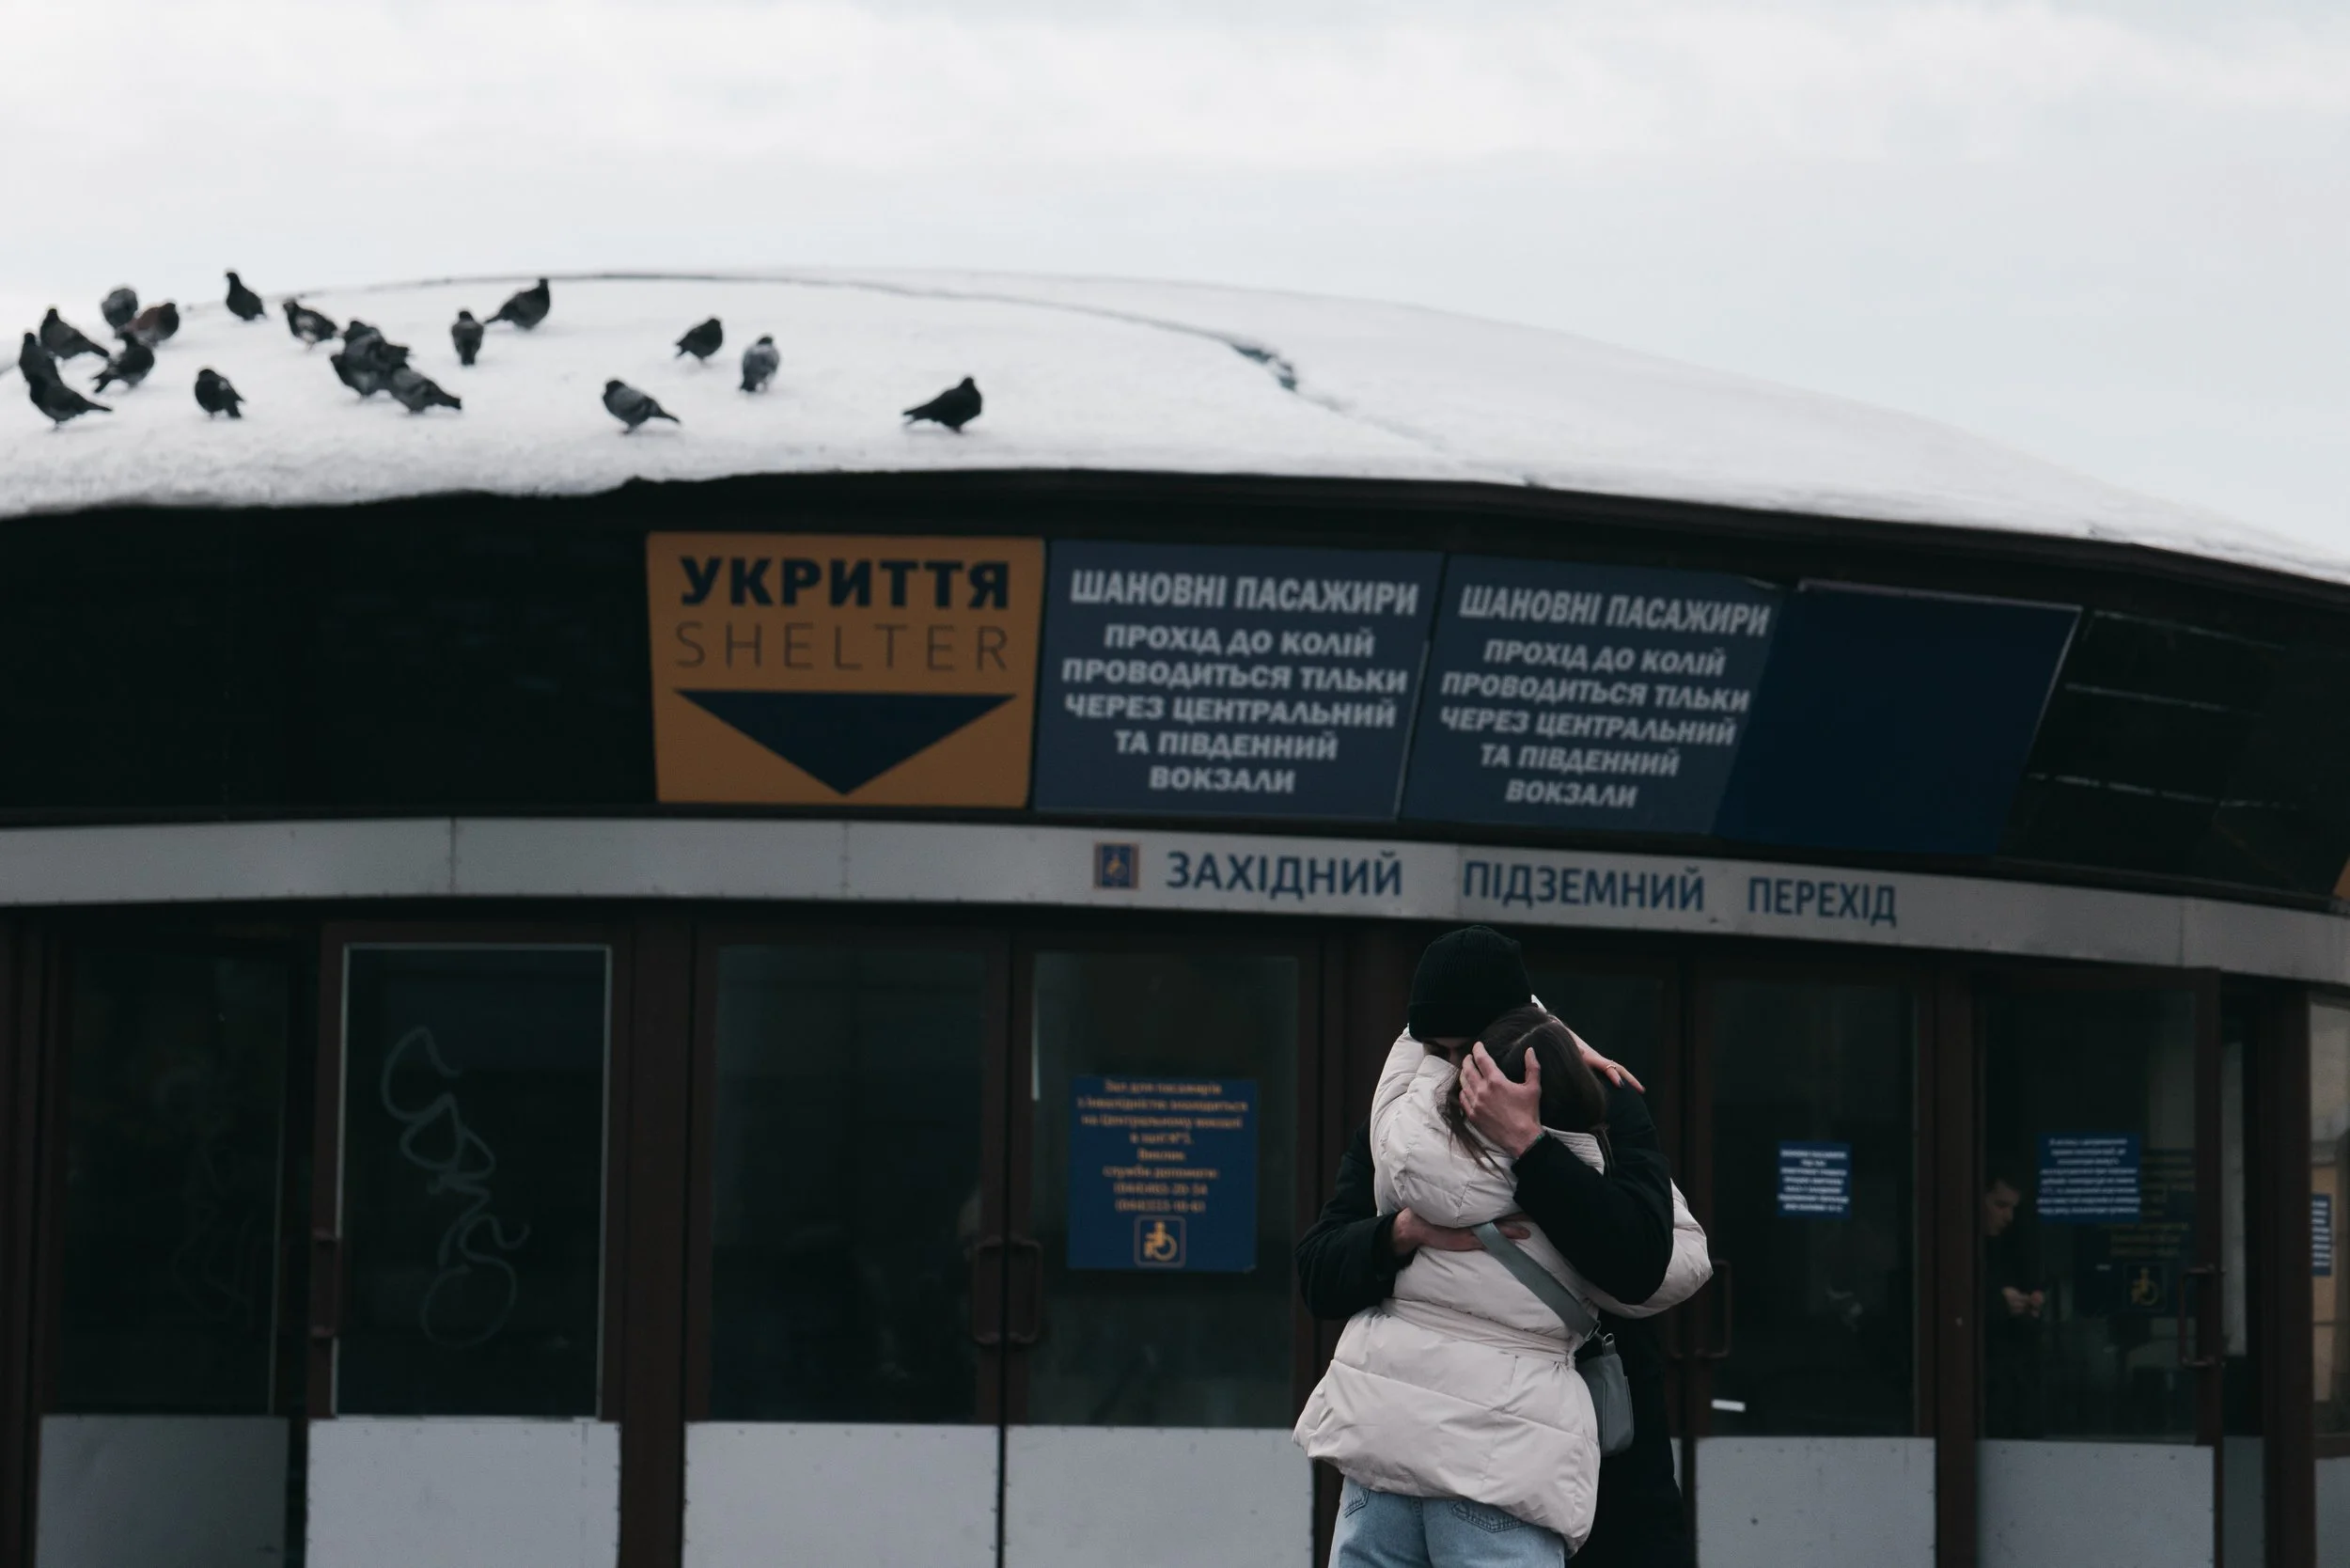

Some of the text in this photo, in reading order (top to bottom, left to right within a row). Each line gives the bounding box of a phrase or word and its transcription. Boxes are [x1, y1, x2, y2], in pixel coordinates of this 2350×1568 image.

[679, 556, 1010, 609] УКРИТТЯ
[1071, 570, 1419, 615] ШАНОВНІ ПАСАЖИРИ
[1459, 585, 1771, 636] ШАНОВНІ ПАСАЖИРИ
[675, 621, 1008, 672] SHELTER
[1104, 623, 1375, 657] ПРОХІД ДО КОЛІЙ
[1483, 639, 1727, 677] ПРОХІД ДО КОЛІЙ
[1061, 659, 1408, 693] ПРОВОДИТЬСЯ ТІЛЬКИ
[1440, 672, 1750, 713] ПРОВОДИТЬСЯ ТІЛЬКИ
[1065, 695, 1398, 729] ЧЕРЕЗ ЦЕНТРАЛЬНИЙ
[1440, 706, 1736, 746] ЧЕРЕЗ ЦЕНТРАЛЬНИЙ
[1115, 730, 1339, 760] ТА ПІВДЕННИЙ
[1480, 744, 1681, 776] ТА ПІВДЕННИЙ
[1149, 766, 1295, 793] ВОКЗАЛИ
[1505, 779, 1637, 808] ВОКЗАЛИ
[1166, 850, 1897, 928] ЗАХІДНИЙ ПІДЗЕМНИЙ ПЕРЕХІД
